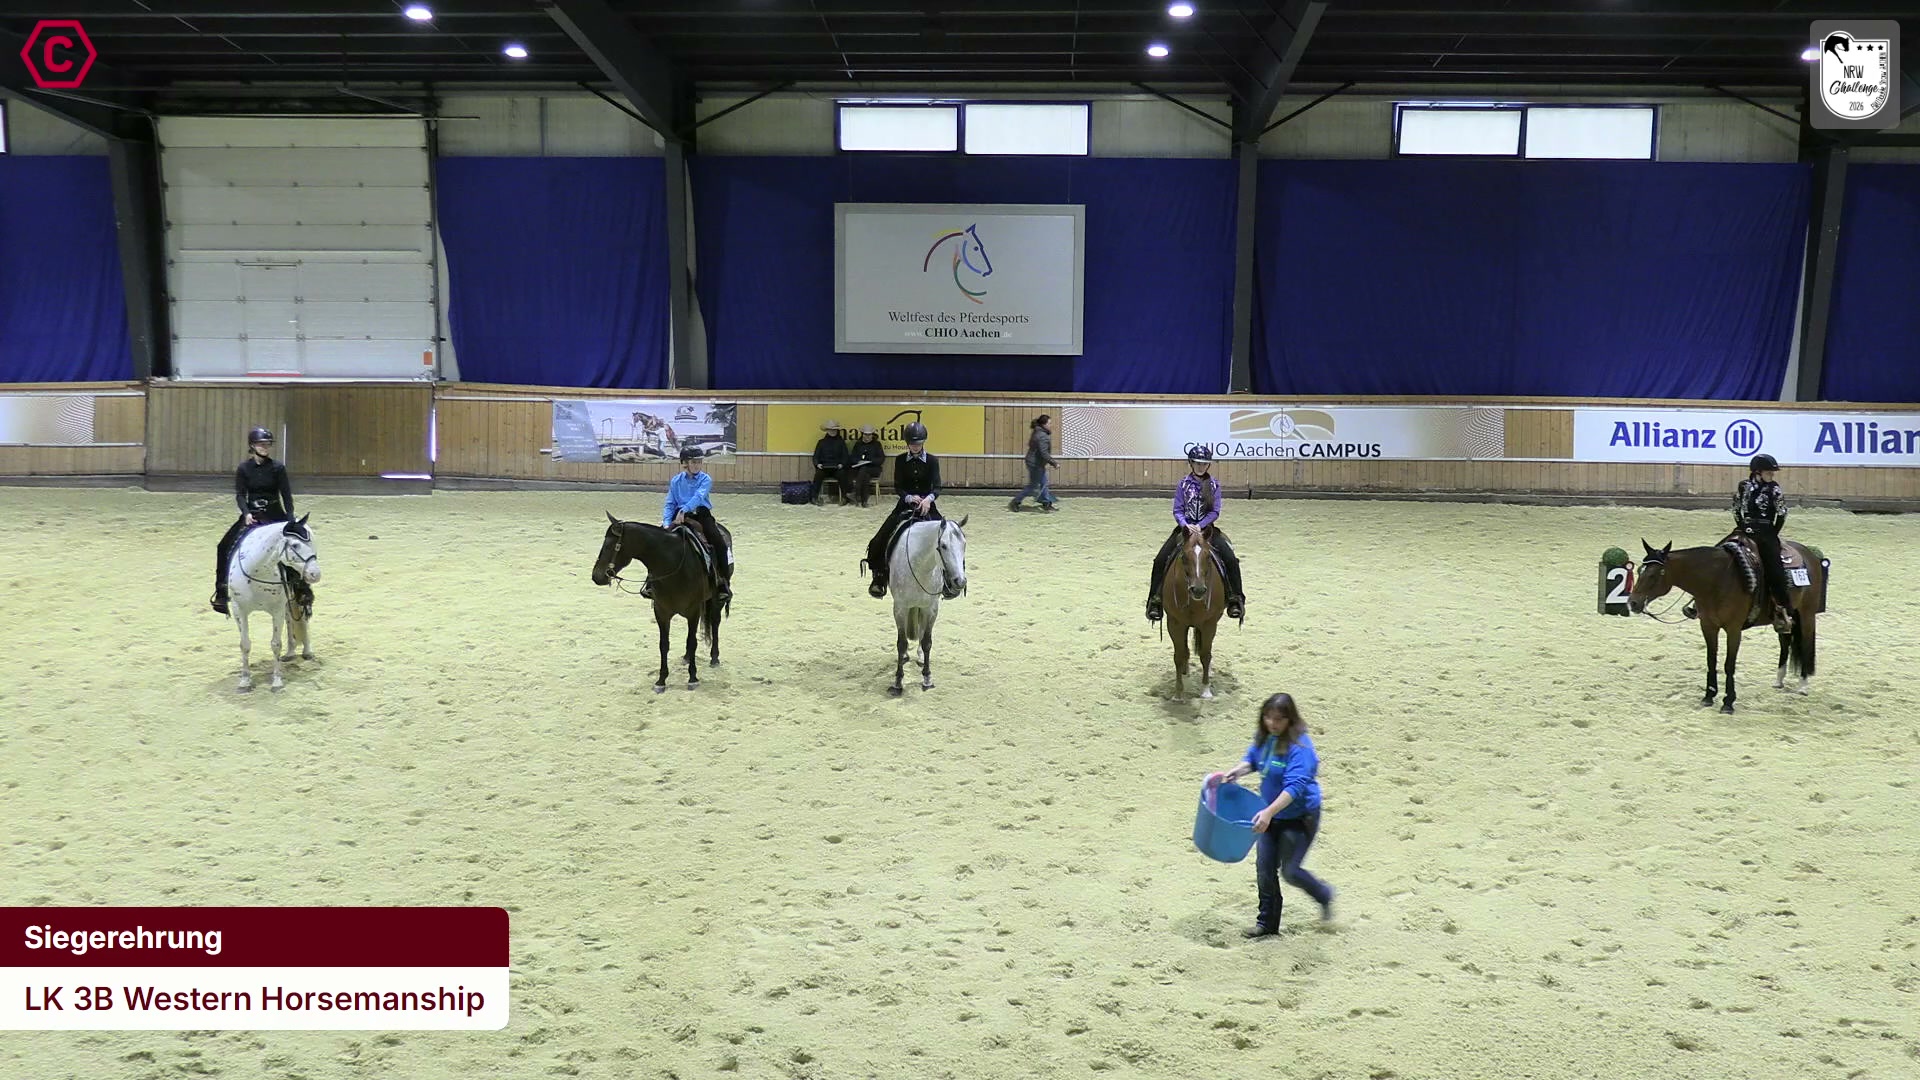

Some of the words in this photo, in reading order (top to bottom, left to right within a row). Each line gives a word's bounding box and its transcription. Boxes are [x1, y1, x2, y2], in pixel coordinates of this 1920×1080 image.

[888, 311, 934, 323] Weltfest
[937, 312, 956, 323] des
[960, 312, 1030, 326] Pferdesports
[924, 327, 959, 338] CHIO
[960, 328, 1001, 338] Aachen
[1609, 421, 1717, 449] Allianz
[1183, 442, 1230, 457] CIO
[1233, 442, 1295, 457] Aachen
[1298, 443, 1381, 458] CAMPUS
[1606, 567, 1630, 604] 2
